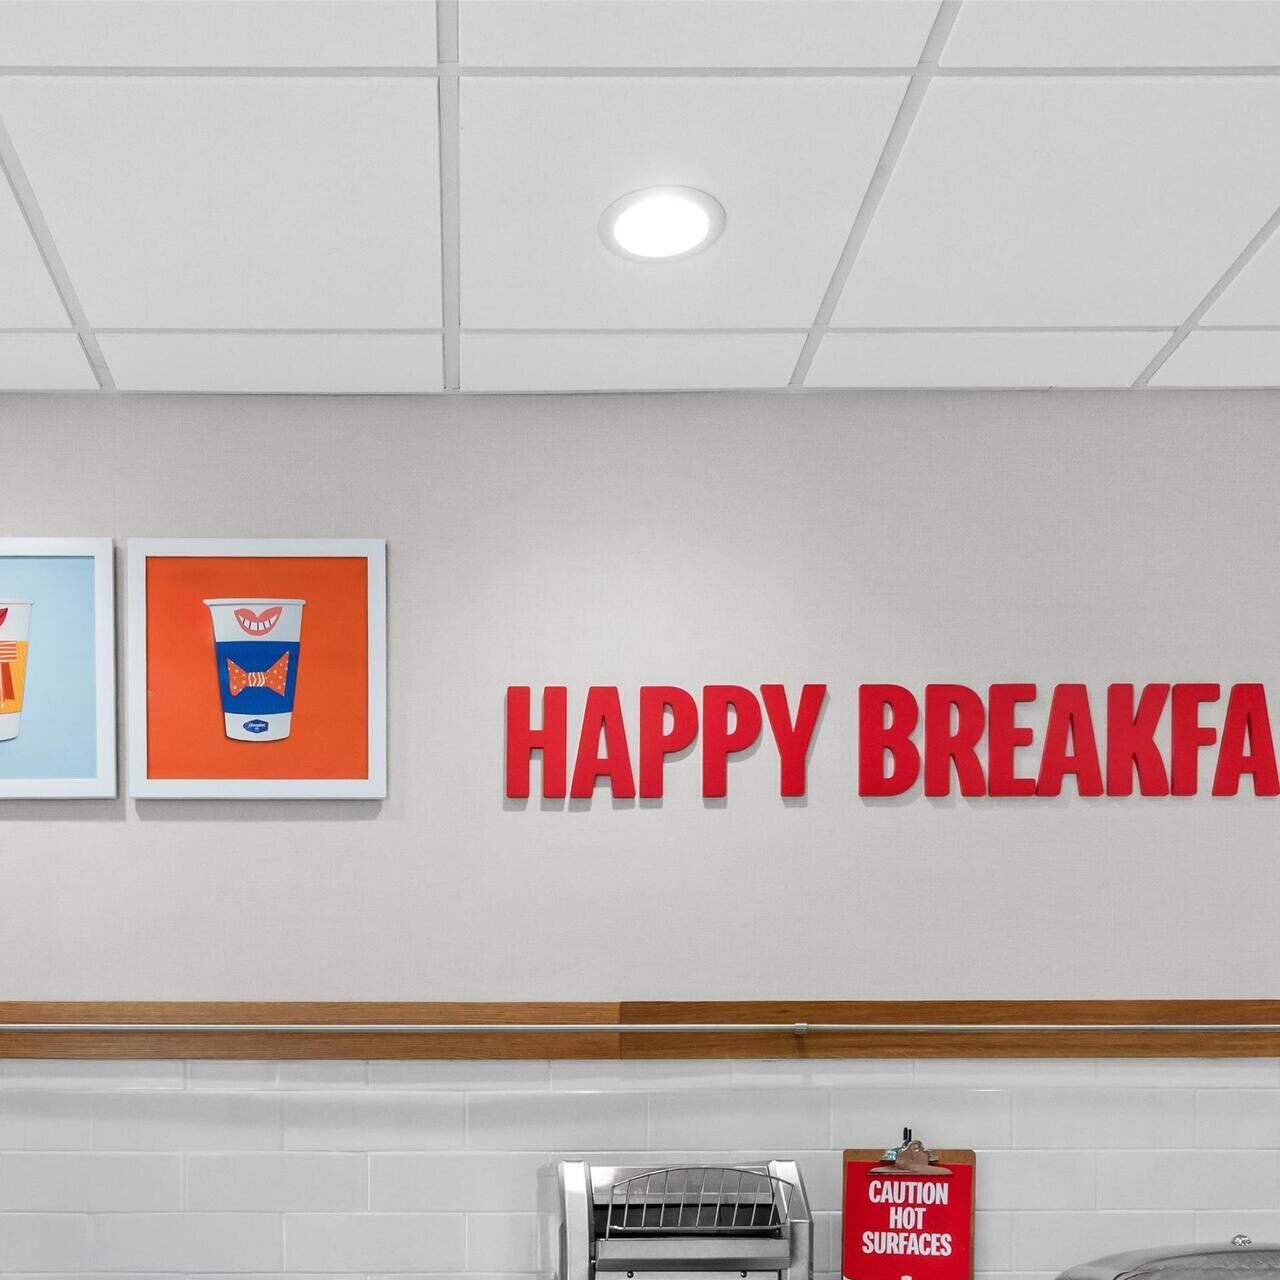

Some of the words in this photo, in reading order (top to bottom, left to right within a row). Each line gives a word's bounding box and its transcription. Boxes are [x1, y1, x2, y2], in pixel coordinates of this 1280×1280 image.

[504, 684, 828, 798] HAPPY
[868, 1180, 949, 1206] CAUTION
[889, 1206, 927, 1230] HOT
[862, 1231, 953, 1257] SURFACES
